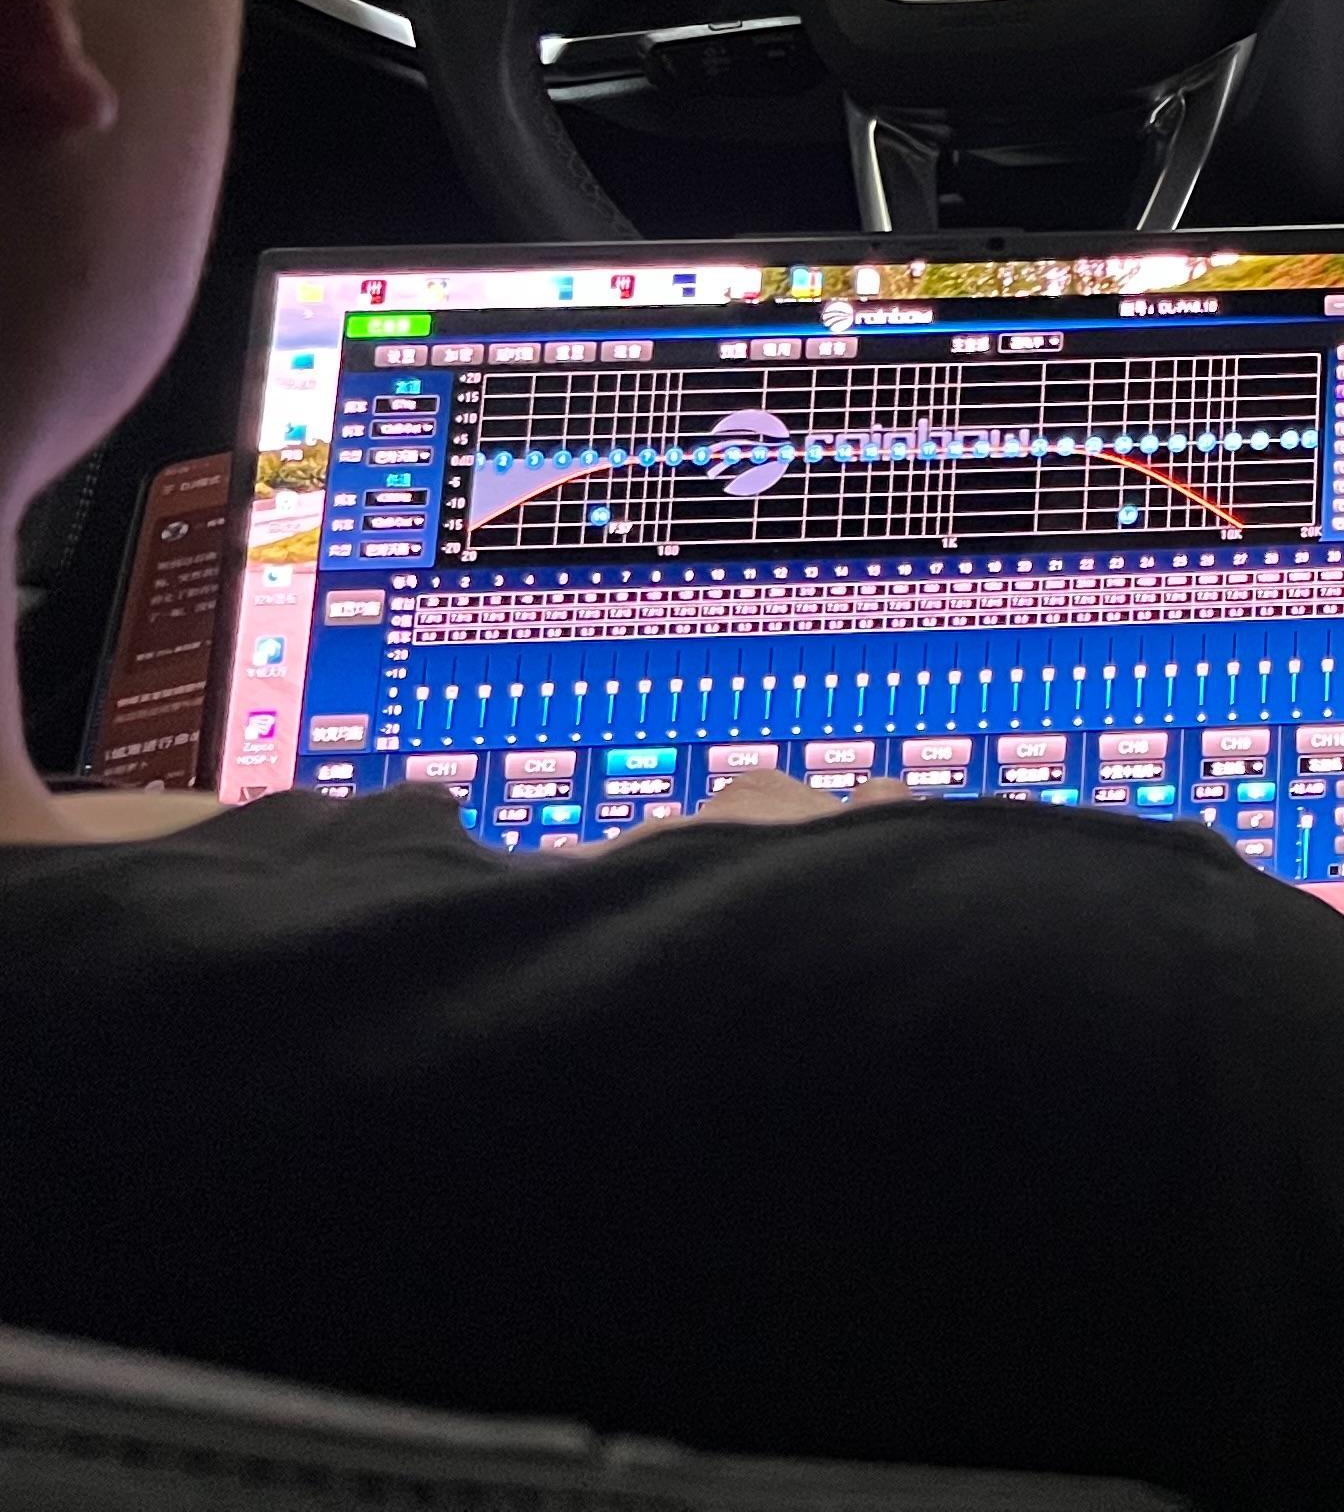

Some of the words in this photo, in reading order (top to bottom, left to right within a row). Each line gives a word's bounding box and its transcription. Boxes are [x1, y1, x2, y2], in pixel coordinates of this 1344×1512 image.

[1016, 742, 1046, 759] CH7
[1117, 739, 1149, 755] CH8
[1220, 736, 1252, 752] CH9
[727, 752, 759, 767] CH4
[824, 749, 856, 763] CH5
[426, 762, 457, 776] CH1
[524, 759, 556, 773] CH2
